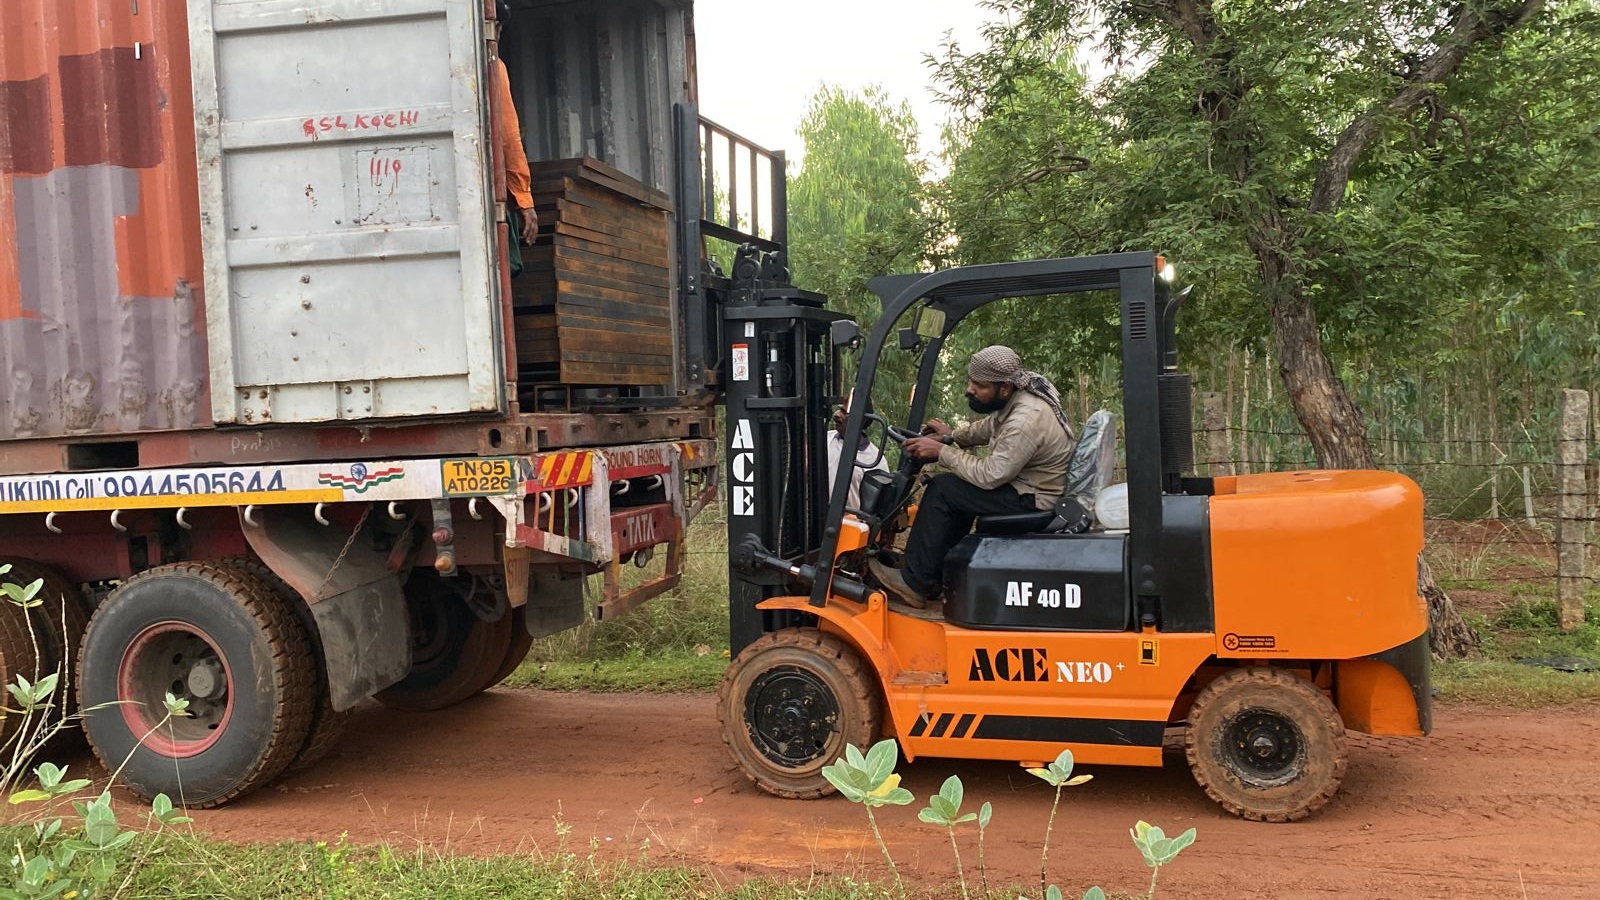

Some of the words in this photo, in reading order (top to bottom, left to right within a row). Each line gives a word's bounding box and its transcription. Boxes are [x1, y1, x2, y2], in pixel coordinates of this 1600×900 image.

[637, 447, 662, 465] HORN
[731, 418, 754, 515] ACE
[103, 469, 286, 498] 9944505644
[627, 512, 656, 546] TATA
[1005, 581, 1032, 606] AF
[1037, 589, 1060, 608] 40
[1065, 583, 1081, 608] D
[969, 648, 1049, 682] ACE
